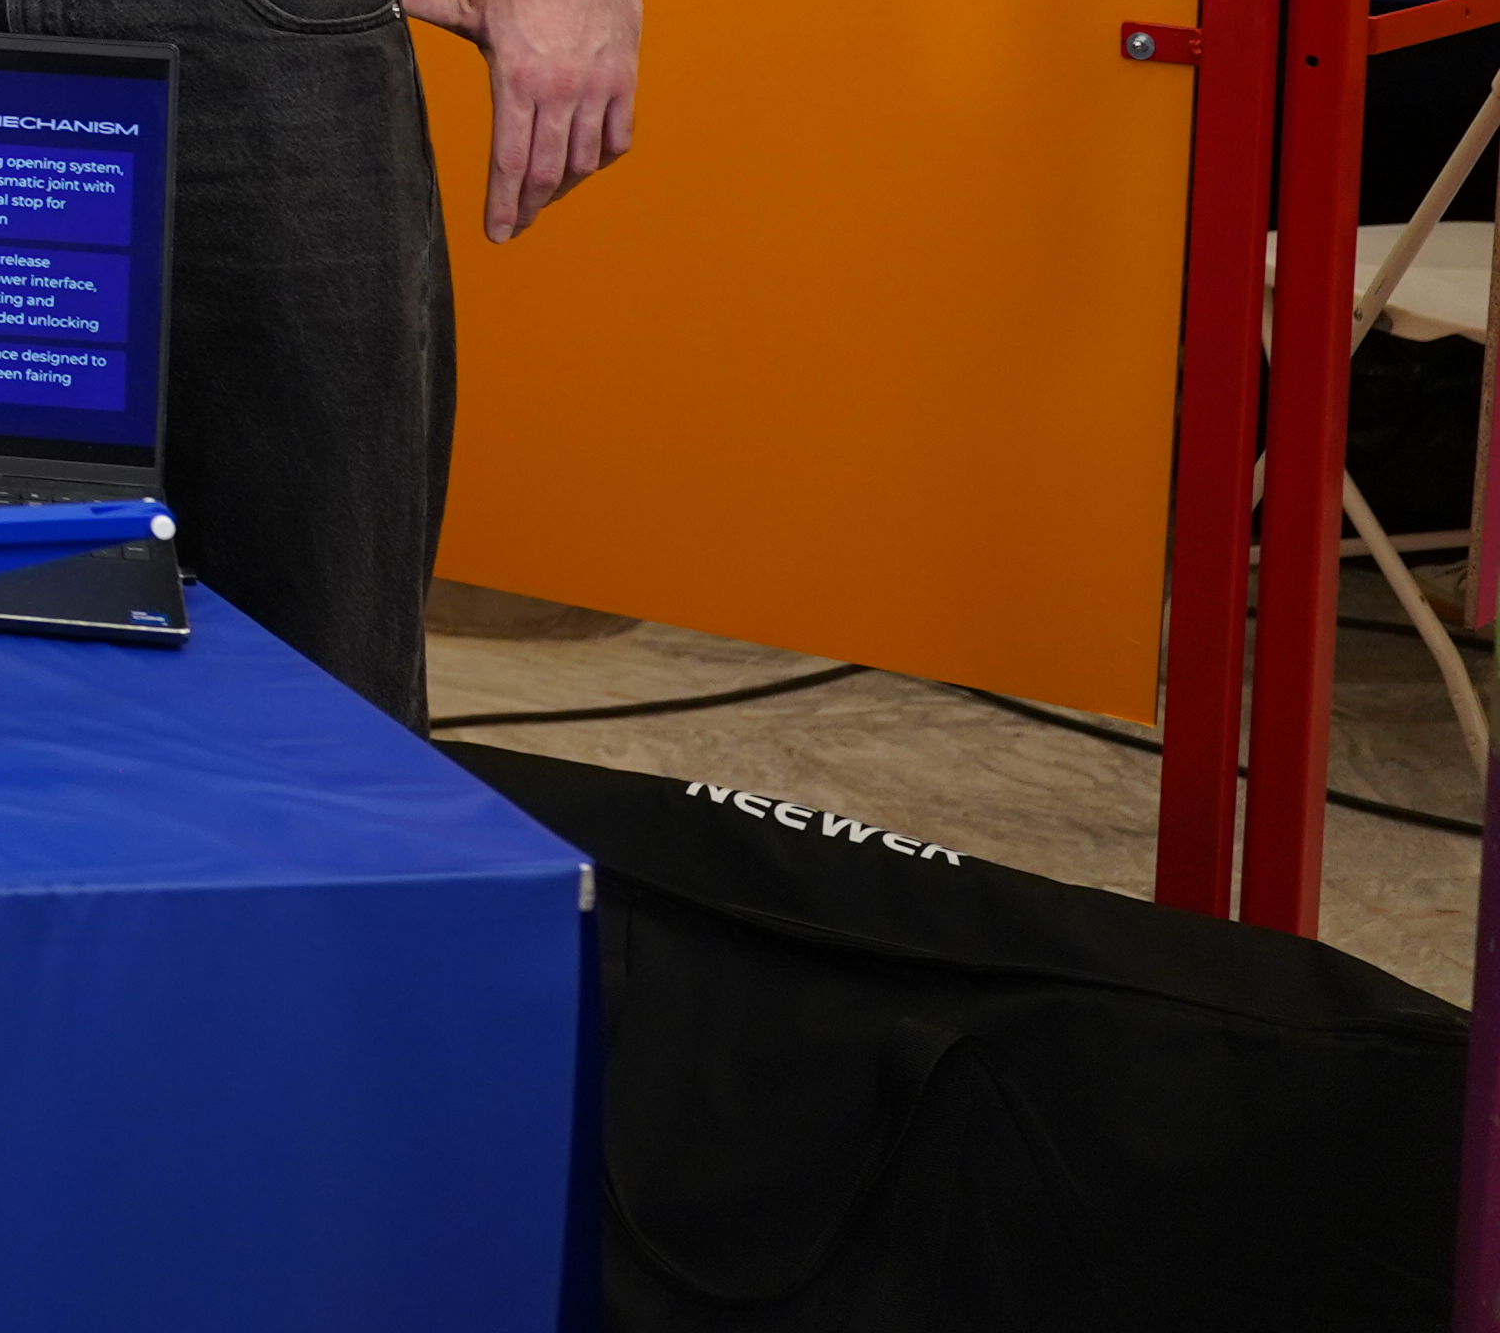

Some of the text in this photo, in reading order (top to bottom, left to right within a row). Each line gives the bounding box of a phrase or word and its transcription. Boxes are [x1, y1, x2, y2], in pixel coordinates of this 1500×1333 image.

[6, 157, 66, 173] opening
[69, 160, 124, 176] system,
[46, 177, 80, 192] joint
[83, 180, 115, 193] with
[11, 196, 43, 211] stop
[46, 196, 66, 209] for
[0, 254, 51, 269] release
[30, 274, 97, 292] interface,
[26, 295, 55, 307] and
[27, 314, 100, 332] unlocking
[21, 349, 88, 366] designed
[91, 355, 107, 367] to
[25, 368, 72, 386] fairing
